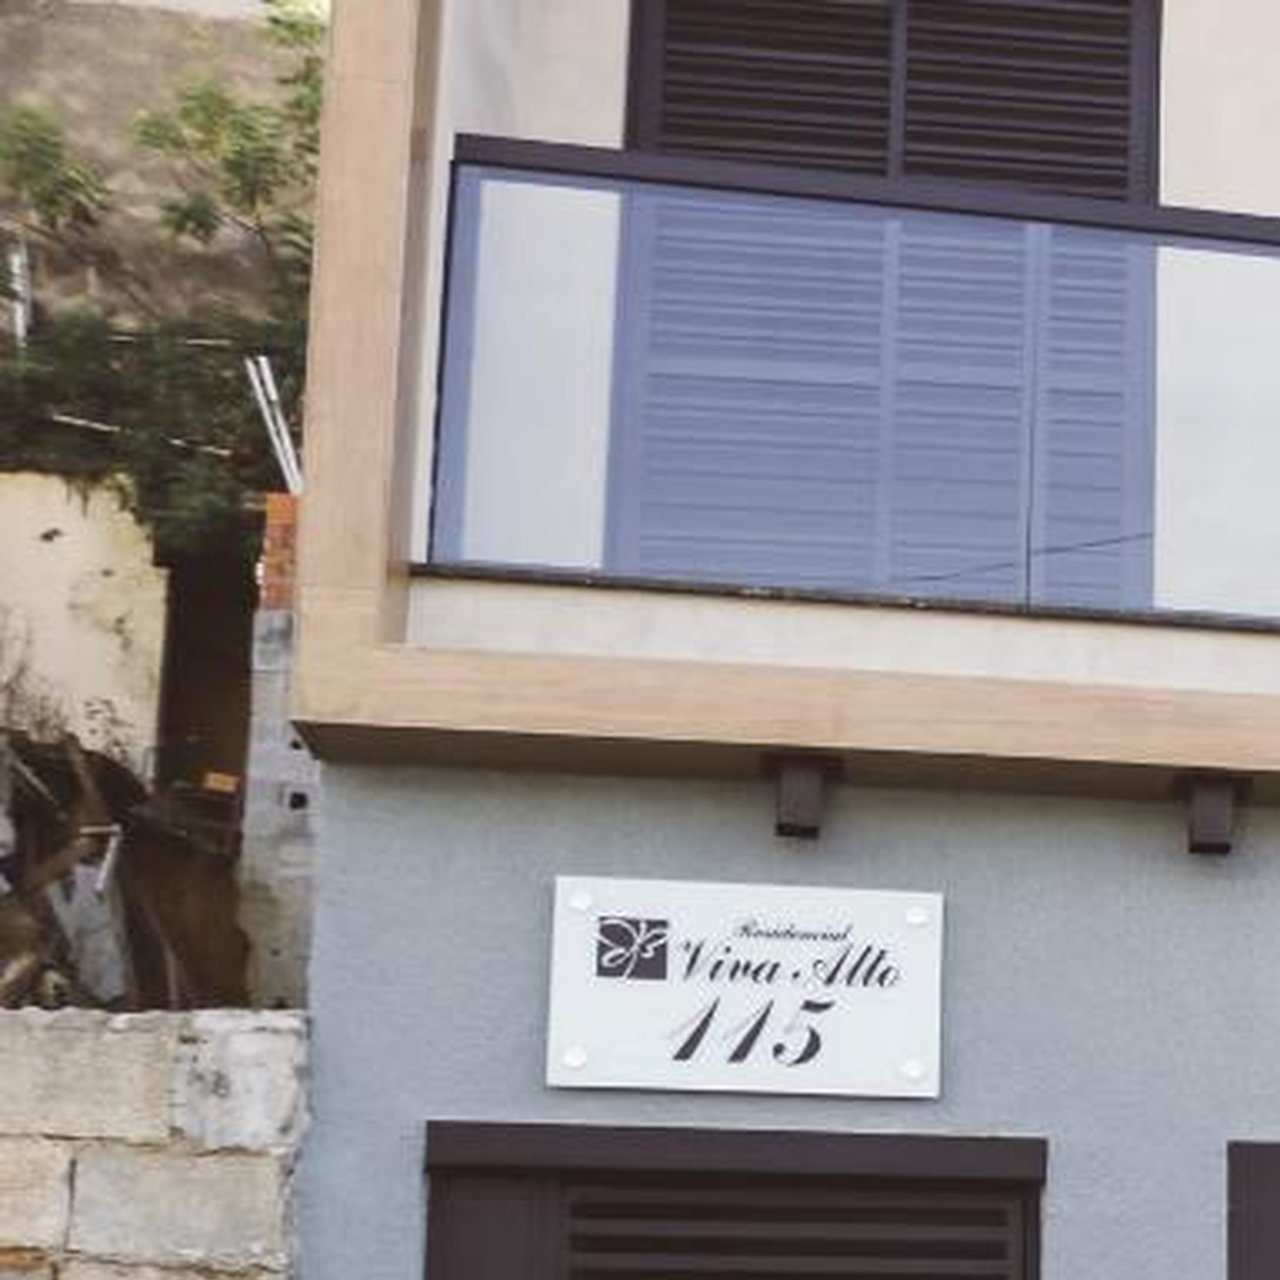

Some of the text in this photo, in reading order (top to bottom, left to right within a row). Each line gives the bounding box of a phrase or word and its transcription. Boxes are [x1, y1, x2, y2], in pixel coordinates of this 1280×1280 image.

[678, 940, 902, 988] Viva Alto
[668, 997, 836, 1067] 115
